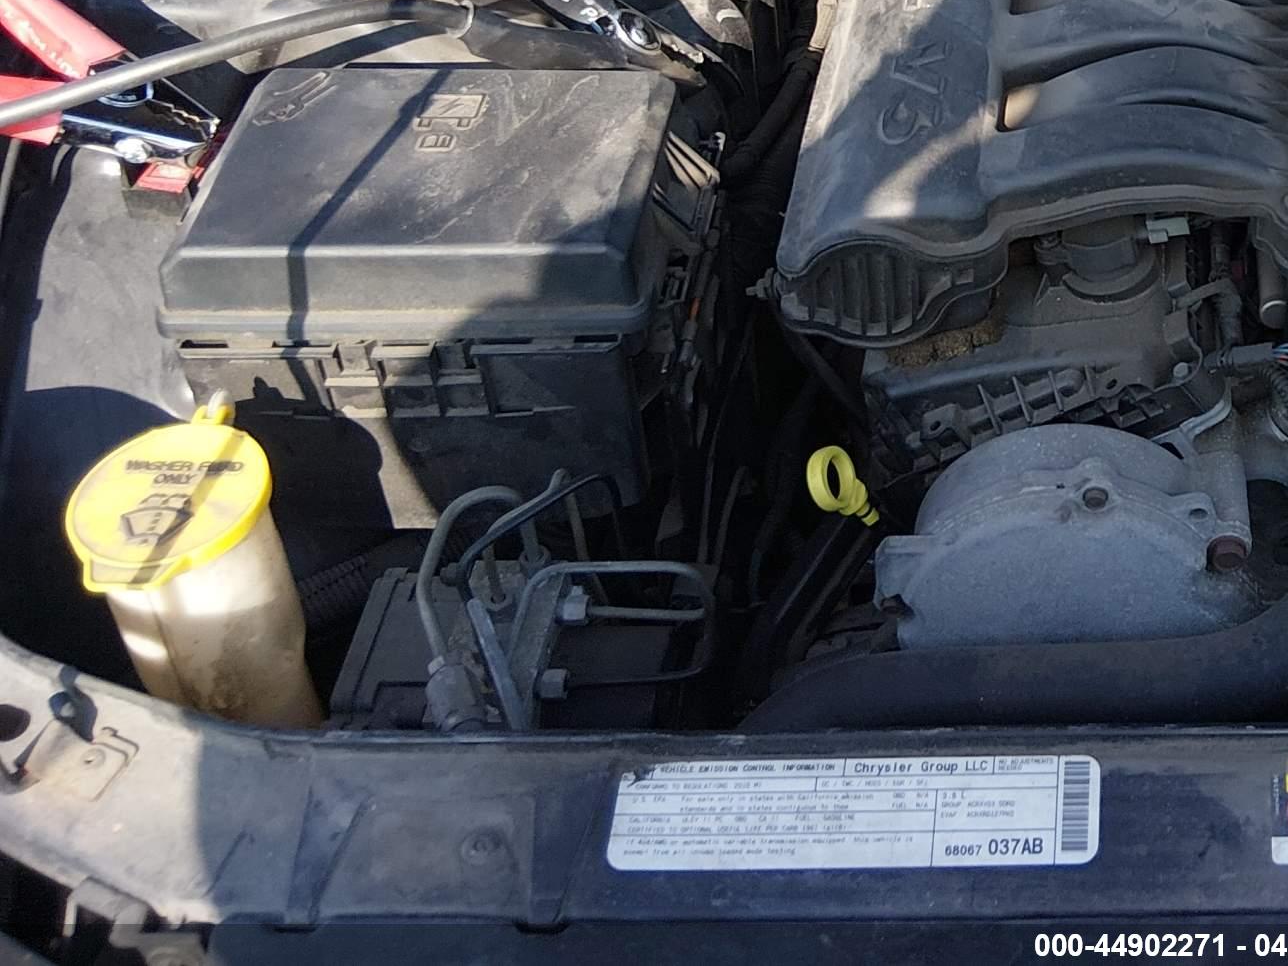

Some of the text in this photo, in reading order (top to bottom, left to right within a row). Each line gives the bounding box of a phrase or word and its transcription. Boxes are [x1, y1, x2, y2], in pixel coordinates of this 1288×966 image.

[125, 459, 193, 472] WASHER
[153, 473, 197, 484] ONLY
[698, 764, 738, 773] EMISSION
[743, 763, 776, 772] CONTROL
[783, 763, 835, 772] INFORMATION
[853, 759, 988, 777] Chrysler Group LLC
[944, 838, 1044, 857] 68067 037AB
